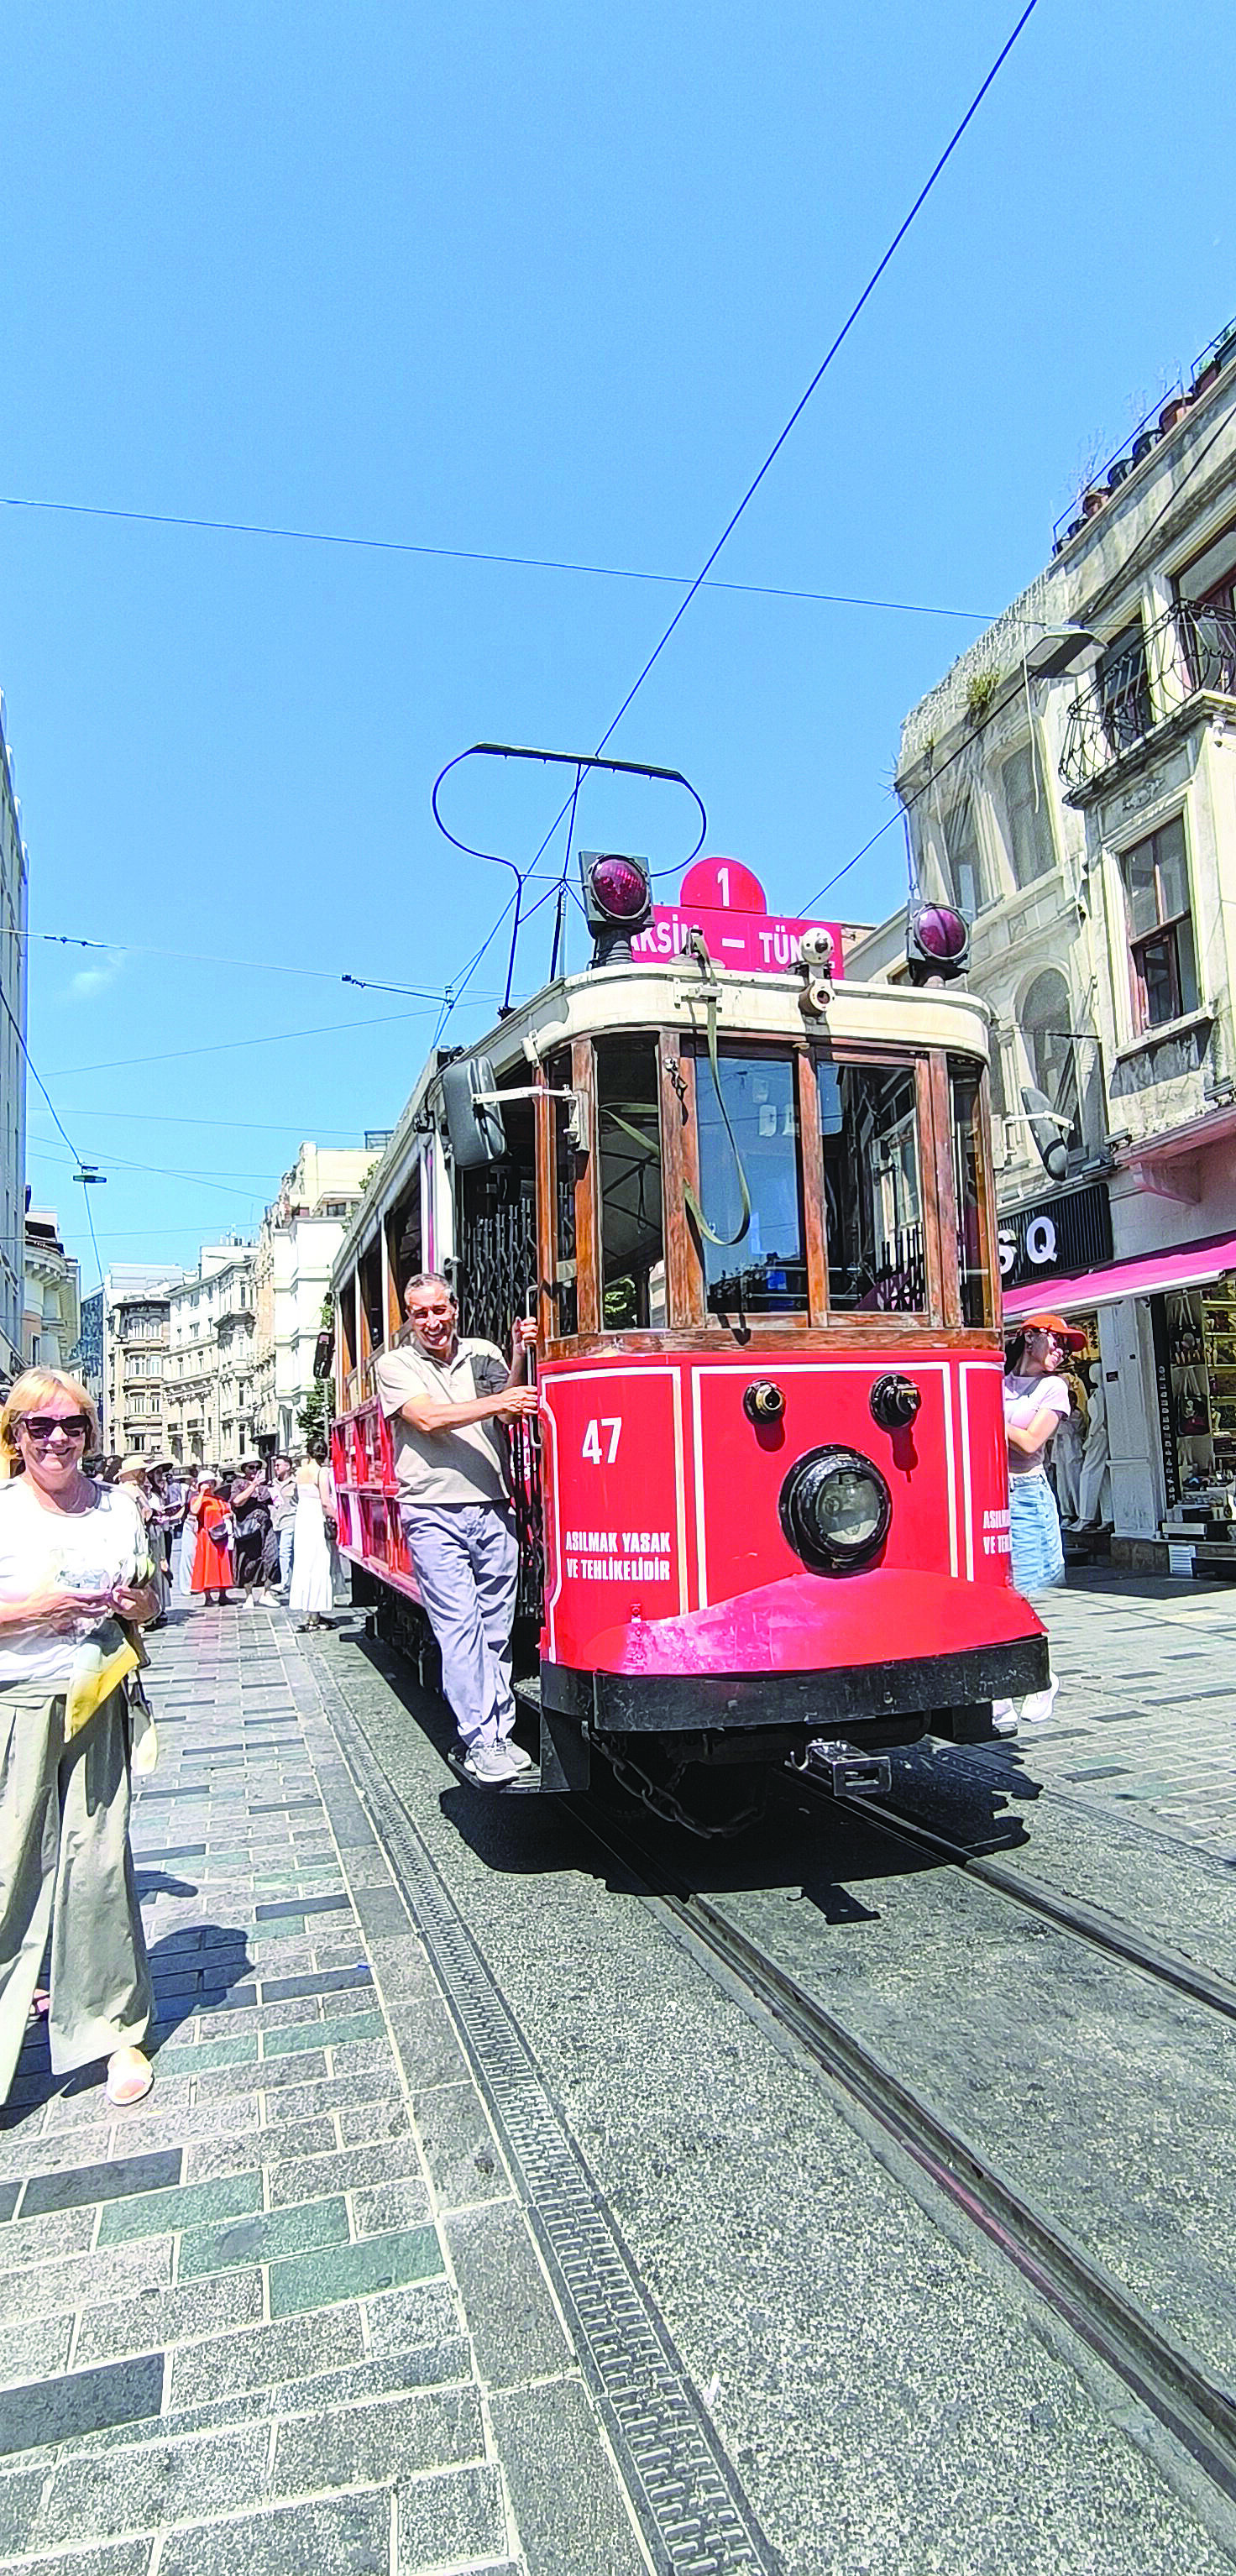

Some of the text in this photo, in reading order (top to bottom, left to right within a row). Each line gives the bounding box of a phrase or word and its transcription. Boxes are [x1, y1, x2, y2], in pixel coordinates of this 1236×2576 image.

[717, 867, 730, 907] 1
[582, 1416, 622, 1464] 47
[565, 1531, 671, 1552] ASILMAK YASAK
[566, 1556, 670, 1580] VE TEHLİKELİDİR
